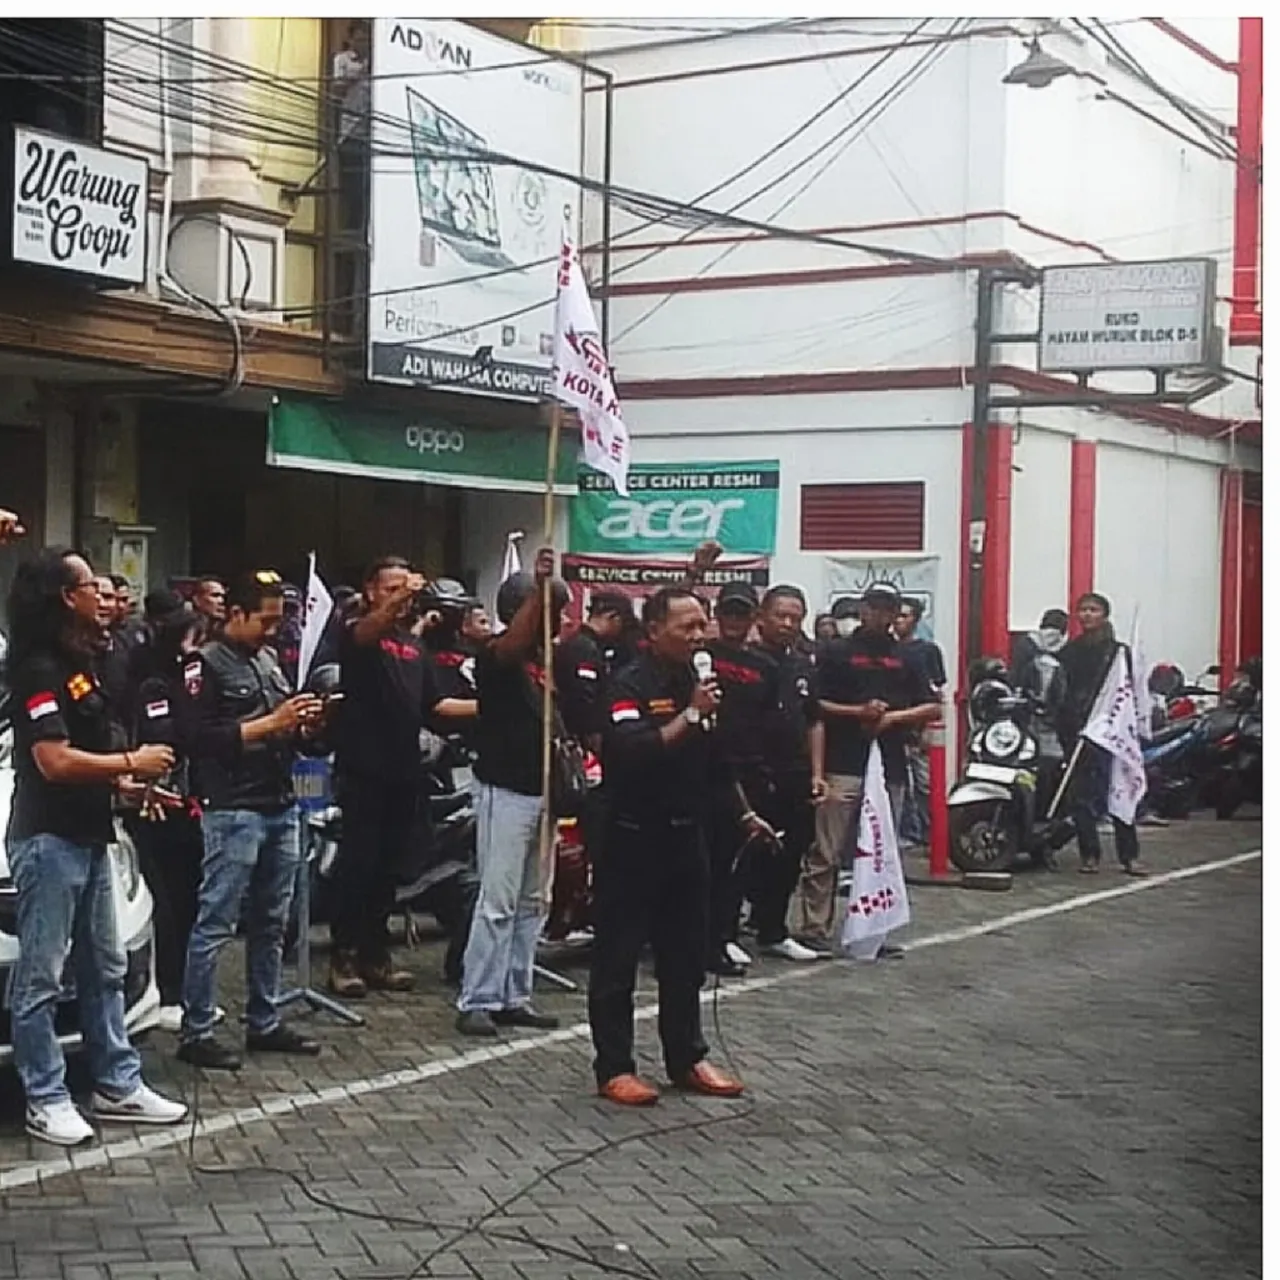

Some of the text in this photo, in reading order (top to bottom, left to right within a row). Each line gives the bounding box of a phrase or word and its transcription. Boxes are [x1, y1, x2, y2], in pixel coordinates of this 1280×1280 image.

[20, 141, 140, 229] Warung
[1048, 330, 1089, 344] HAYAM
[1140, 328, 1173, 342] BLOK
[402, 354, 427, 376] ADI
[495, 369, 554, 394] COMPUTE
[563, 371, 604, 409] KOTA
[406, 426, 464, 454] oppo
[586, 473, 761, 489] SERCE CENTER RESMI
[598, 498, 745, 539] acer
[578, 567, 638, 582] SERVICE
